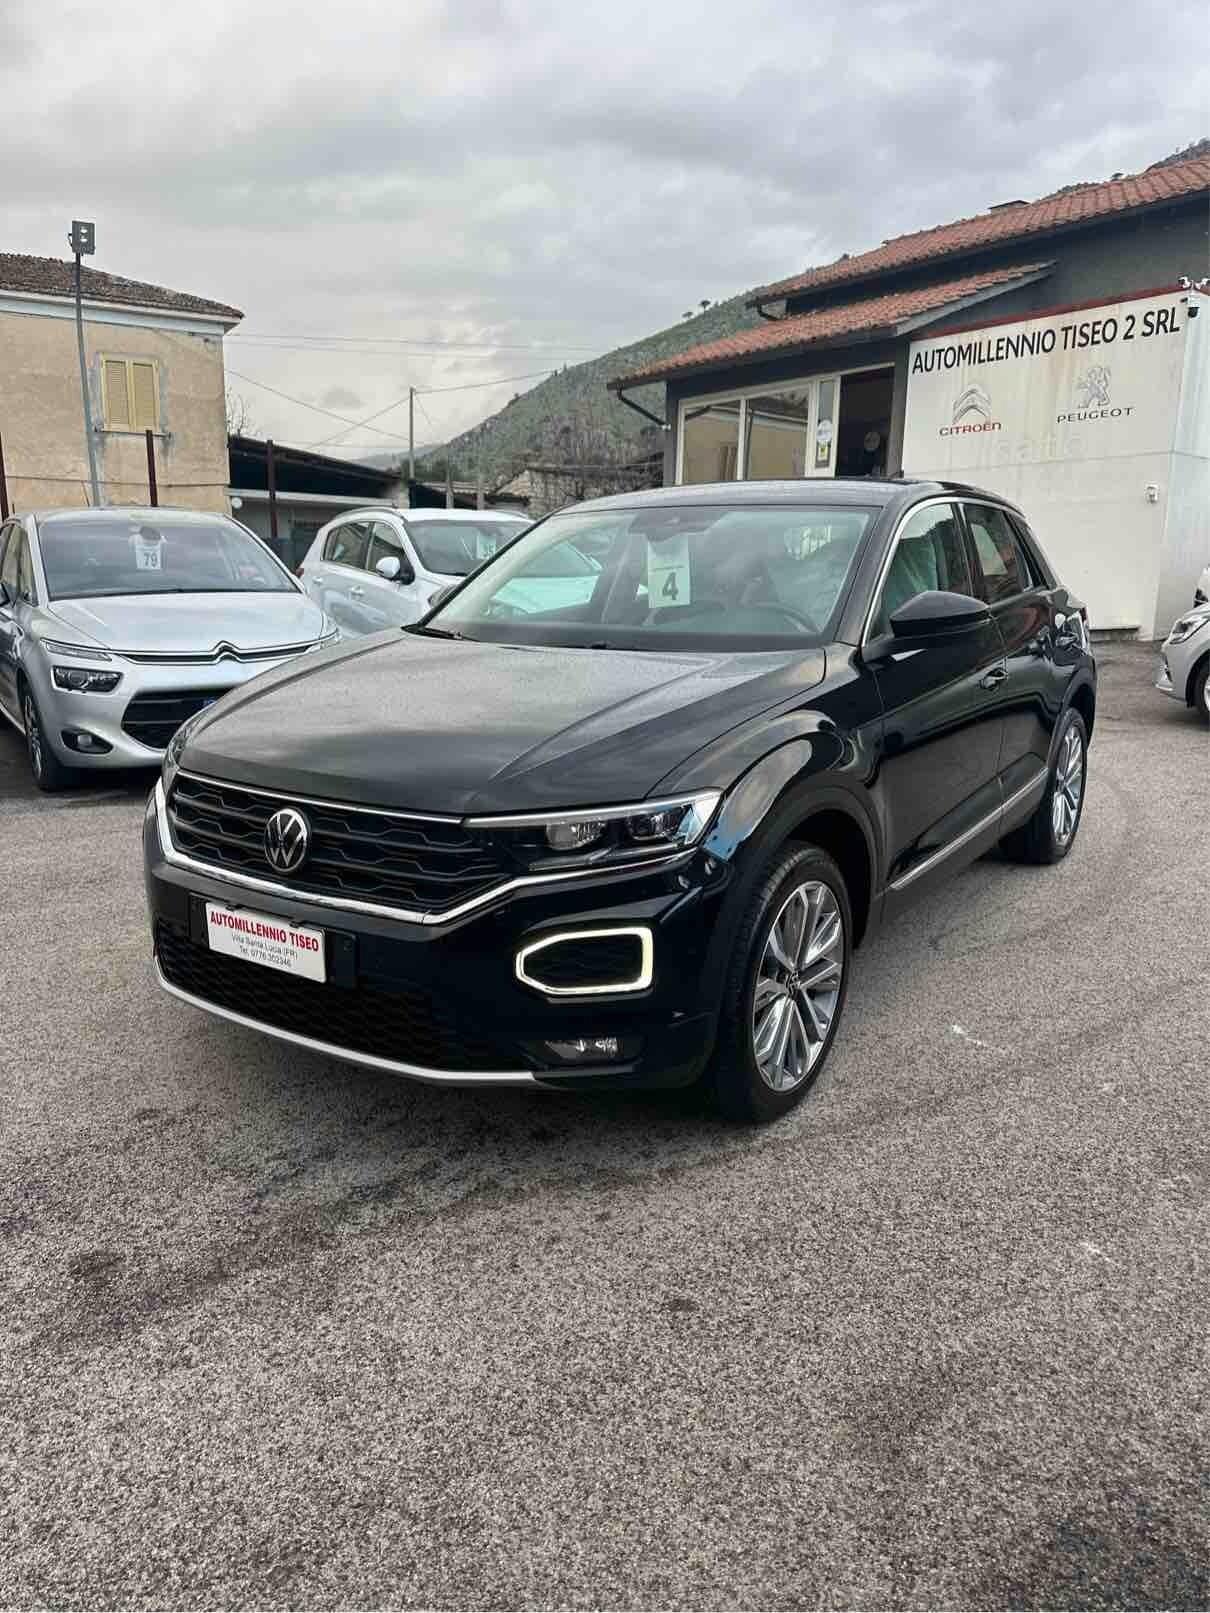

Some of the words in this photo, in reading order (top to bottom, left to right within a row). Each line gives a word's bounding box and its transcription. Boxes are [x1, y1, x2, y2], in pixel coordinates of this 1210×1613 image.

[912, 329, 1056, 375] AUTOMILLENNIO
[1061, 318, 1118, 351] TISEO
[1123, 315, 1136, 340] 2
[1141, 307, 1181, 338] SRL
[1057, 407, 1134, 424] PEUGEOT
[143, 552, 158, 568] 79
[662, 572, 679, 601] 4
[210, 911, 287, 943] AUTOMILLENNIO
[289, 932, 319, 952] TISEO
